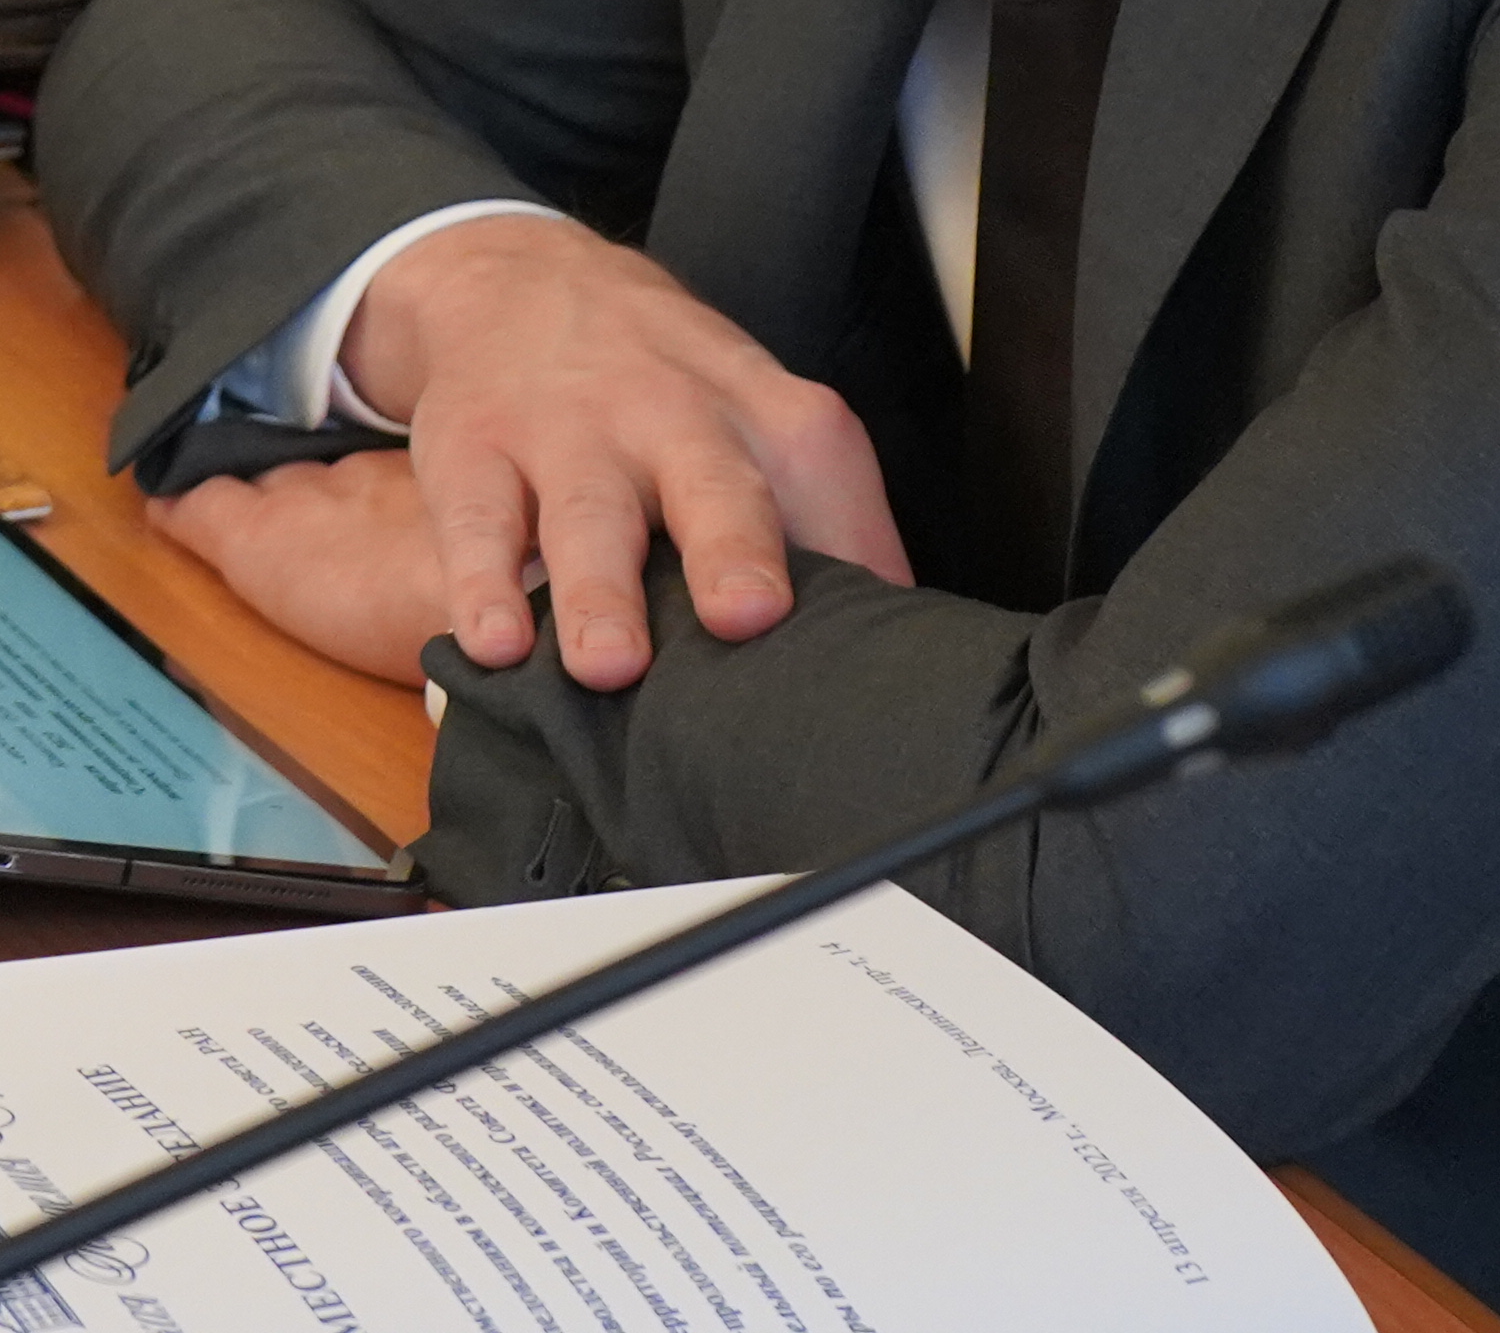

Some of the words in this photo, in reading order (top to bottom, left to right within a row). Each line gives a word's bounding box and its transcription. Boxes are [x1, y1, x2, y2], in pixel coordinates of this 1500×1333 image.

[820, 942, 851, 955] 14
[177, 1027, 227, 1055] РАН
[885, 986, 993, 1057] Ленинский
[219, 1055, 275, 1095] совета
[991, 1059, 1065, 1122] Москва,
[455, 1095, 516, 1144] Совета
[515, 1094, 596, 1158] политике
[392, 1152, 461, 1212] области
[511, 1145, 595, 1221] Комитета
[1073, 1144, 1127, 1183] 2023
[1120, 1187, 1189, 1255] апреля
[815, 1276, 845, 1299] по
[1175, 1261, 1209, 1285] 13
